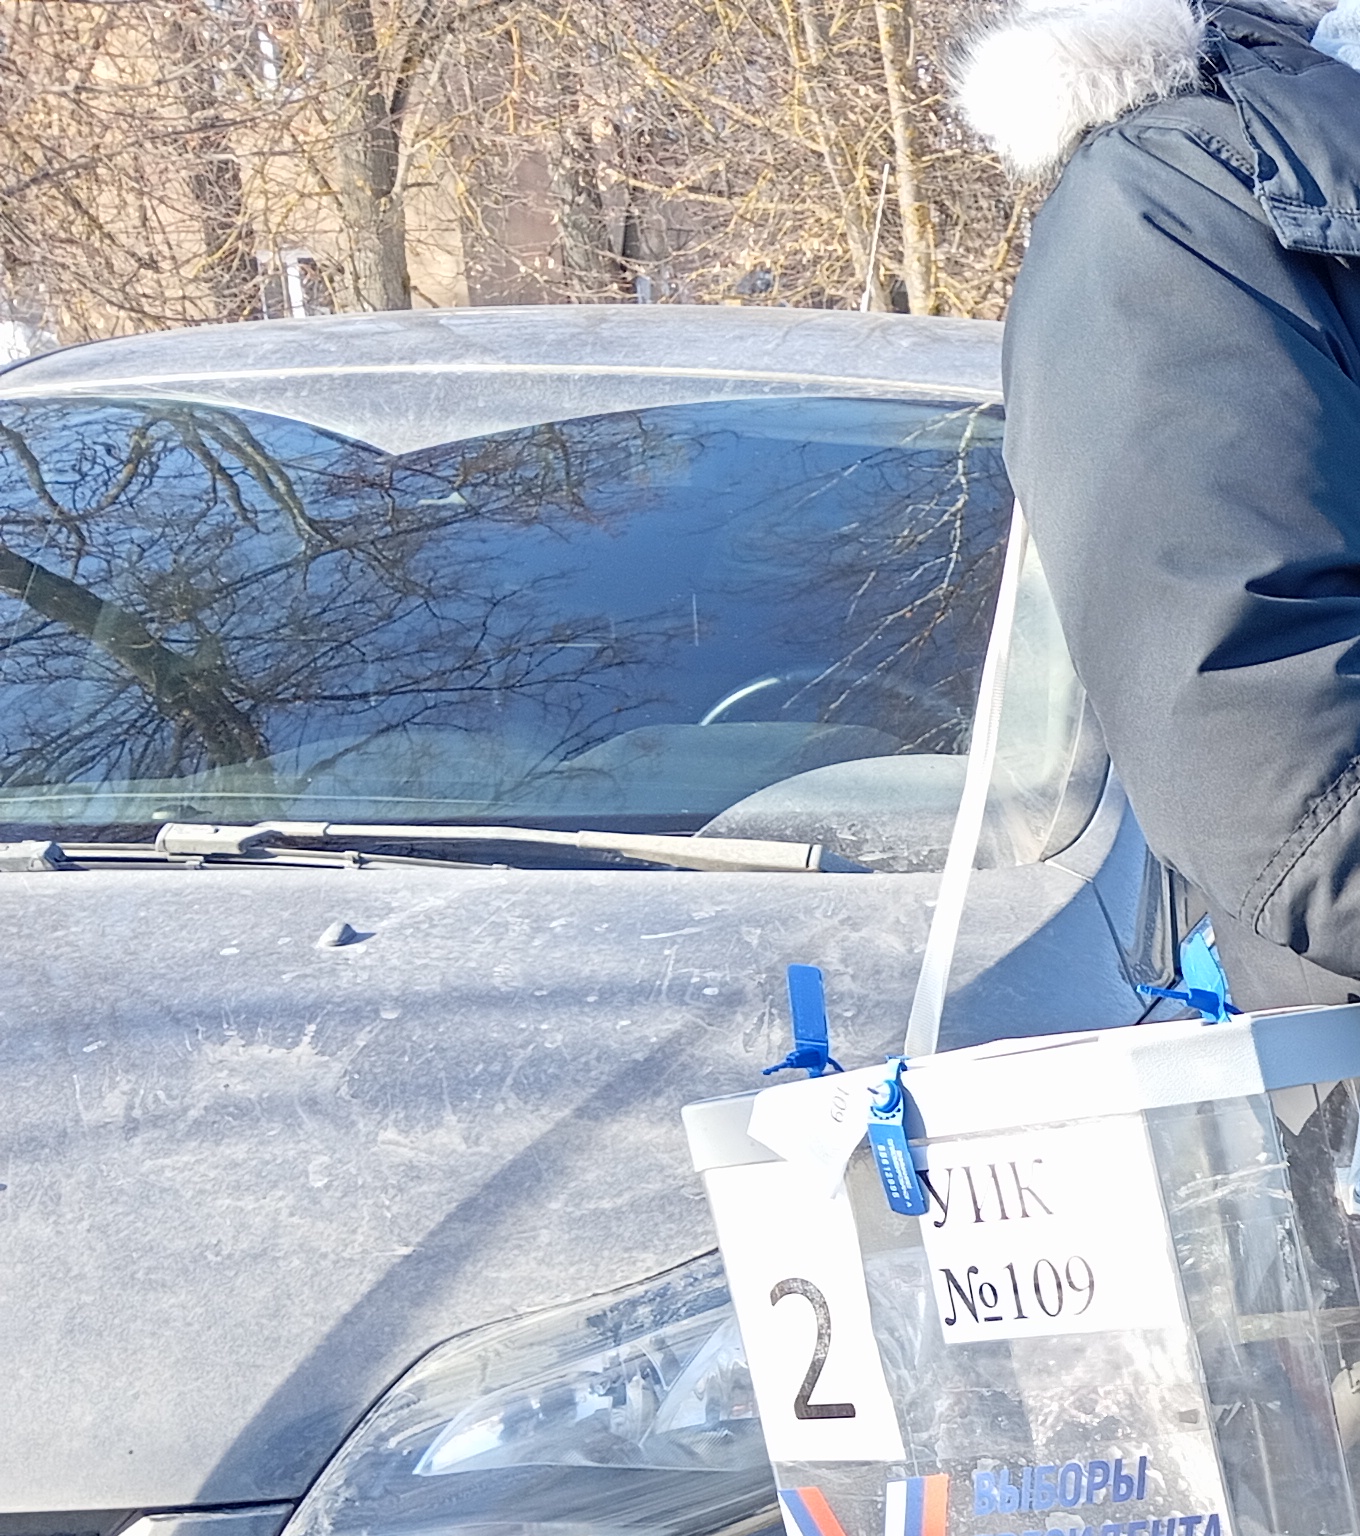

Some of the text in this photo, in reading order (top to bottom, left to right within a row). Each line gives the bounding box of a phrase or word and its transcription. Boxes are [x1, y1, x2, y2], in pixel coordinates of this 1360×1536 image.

[916, 1158, 1054, 1228] УИК
[938, 1255, 1095, 1326] №109
[769, 1277, 856, 1420] 2
[973, 1455, 1148, 1517] ВЫБОРЫ
